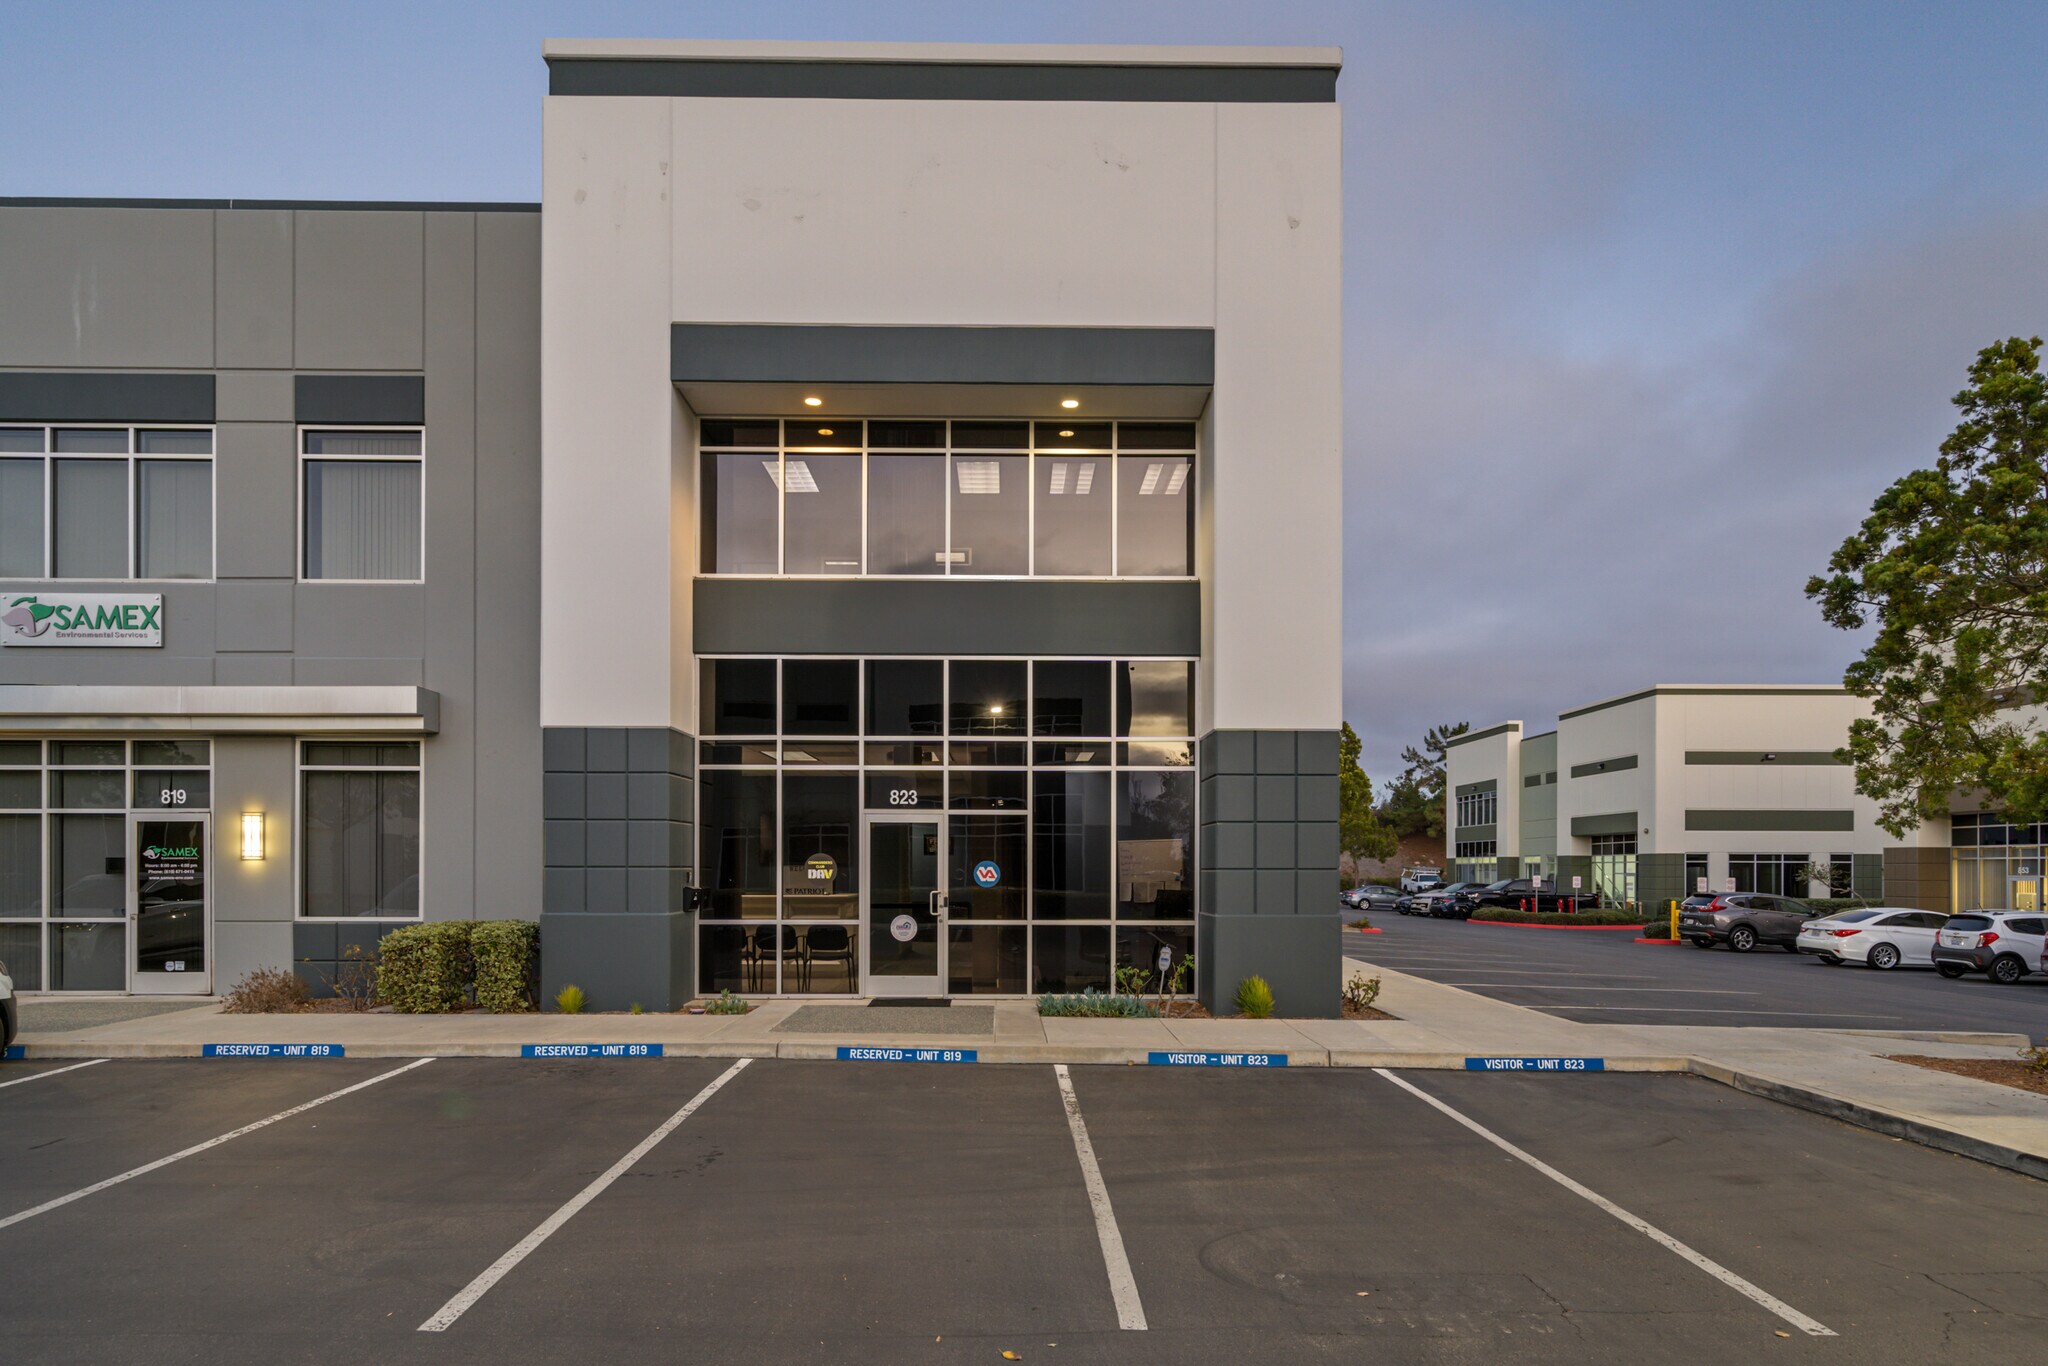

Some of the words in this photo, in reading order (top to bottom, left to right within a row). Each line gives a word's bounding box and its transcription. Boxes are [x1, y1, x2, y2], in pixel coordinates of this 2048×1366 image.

[53, 605, 160, 631] SAMEX
[56, 631, 113, 639] Environmental
[115, 631, 148, 639] Services
[161, 789, 187, 804] 819
[890, 790, 918, 805] 823
[161, 847, 198, 857] SAMEX
[808, 869, 833, 879] DAV
[976, 866, 998, 882] VA
[216, 1045, 270, 1056] RESERVED
[284, 1045, 307, 1056] UNIT
[311, 1045, 330, 1056] 819
[534, 1046, 588, 1056] RESERVED
[602, 1045, 625, 1056] UNIT
[629, 1045, 648, 1055] 819
[850, 1049, 903, 1060] RESERVED
[916, 1050, 939, 1061] UNIT
[943, 1051, 962, 1061] 819
[1168, 1054, 1207, 1065] VISITOR
[1221, 1055, 1244, 1065] UNIT
[1247, 1055, 1269, 1066] 823
[1484, 1059, 1524, 1070] VISITOR
[1537, 1059, 1560, 1070] UNIT
[1564, 1059, 1585, 1070] 823
